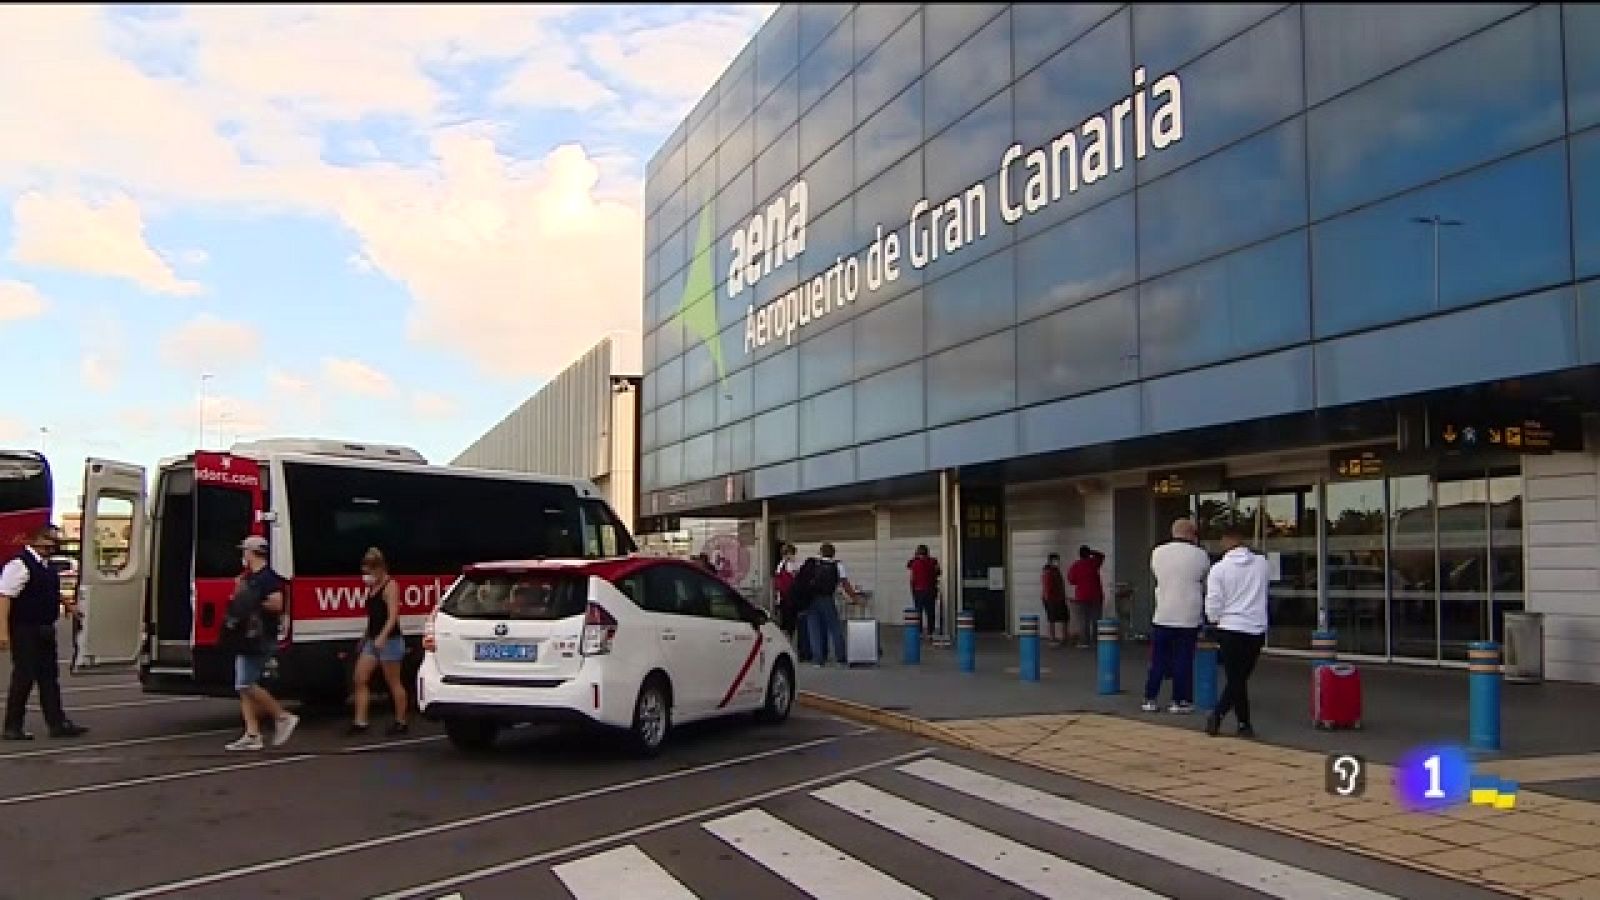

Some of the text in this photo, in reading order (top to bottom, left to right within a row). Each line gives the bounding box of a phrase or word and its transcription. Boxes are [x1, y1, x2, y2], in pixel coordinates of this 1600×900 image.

[728, 180, 808, 297] aena
[744, 66, 1184, 353] Aeropuerto de Gran Canaria
